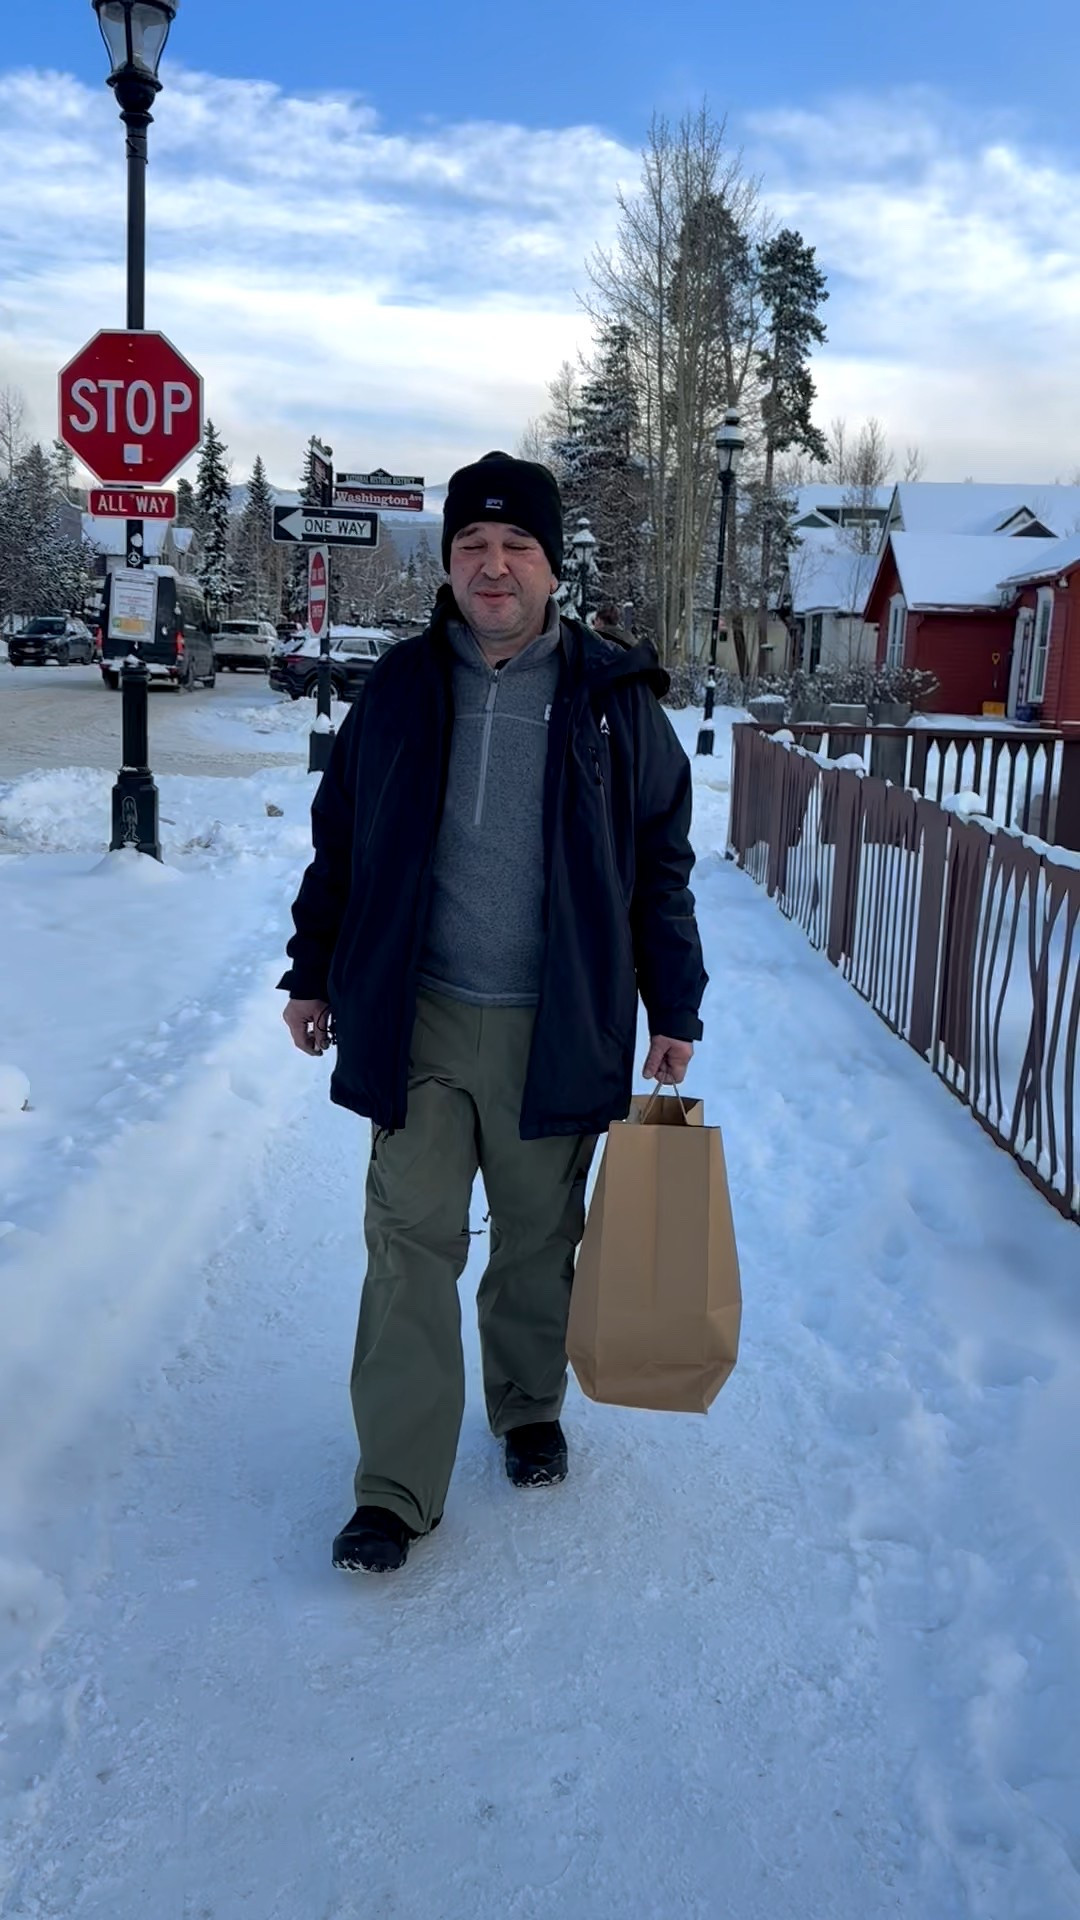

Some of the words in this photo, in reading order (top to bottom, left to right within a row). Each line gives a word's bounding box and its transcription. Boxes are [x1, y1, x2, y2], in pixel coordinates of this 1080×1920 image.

[69, 378, 192, 435] STOP
[98, 495, 128, 512] ALL
[136, 496, 168, 513] WAY
[336, 491, 409, 506] Washington
[304, 518, 333, 534] ONE
[338, 522, 367, 536] WAY
